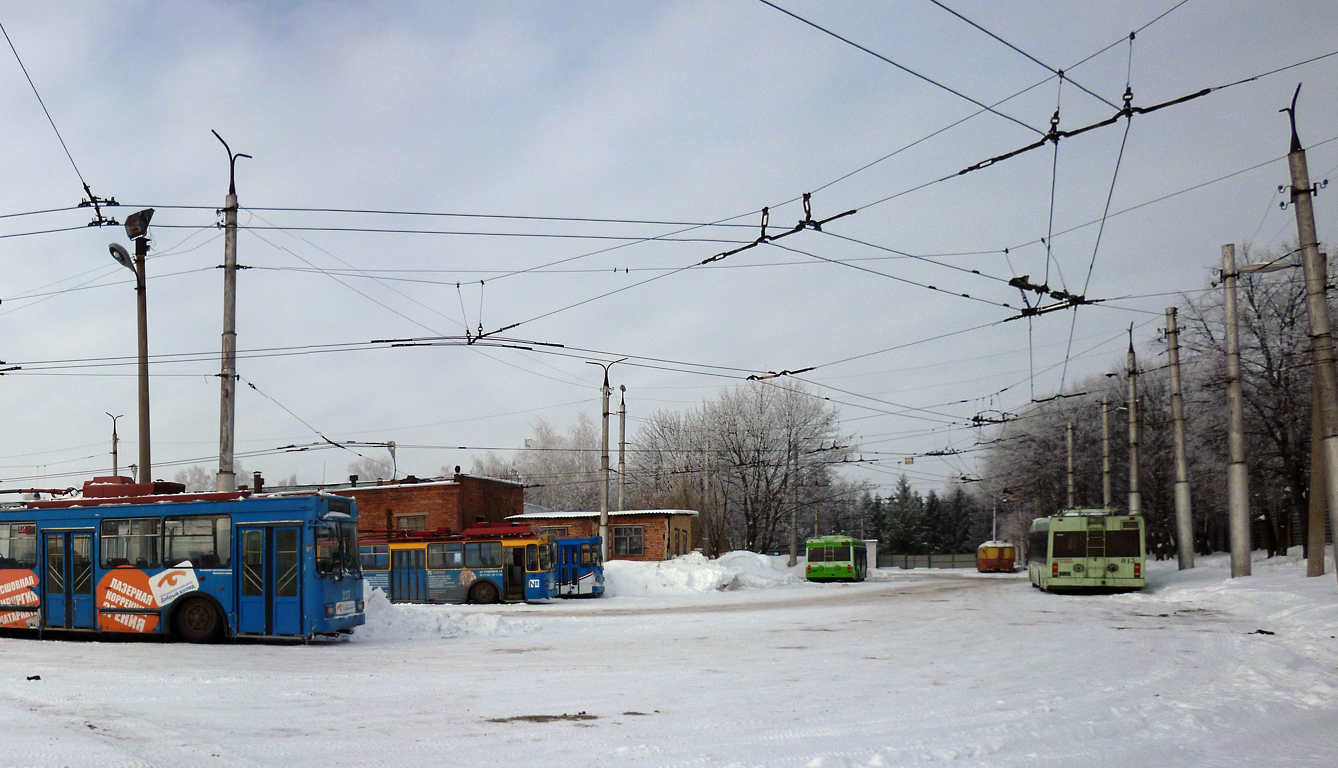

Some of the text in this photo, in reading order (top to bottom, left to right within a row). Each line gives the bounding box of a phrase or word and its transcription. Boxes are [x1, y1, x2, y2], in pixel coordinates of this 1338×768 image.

[18, 525, 32, 534] 225
[105, 590, 147, 612] КОРРЕКЦ
[110, 577, 153, 605] ЛАЗЕРНАЯ
